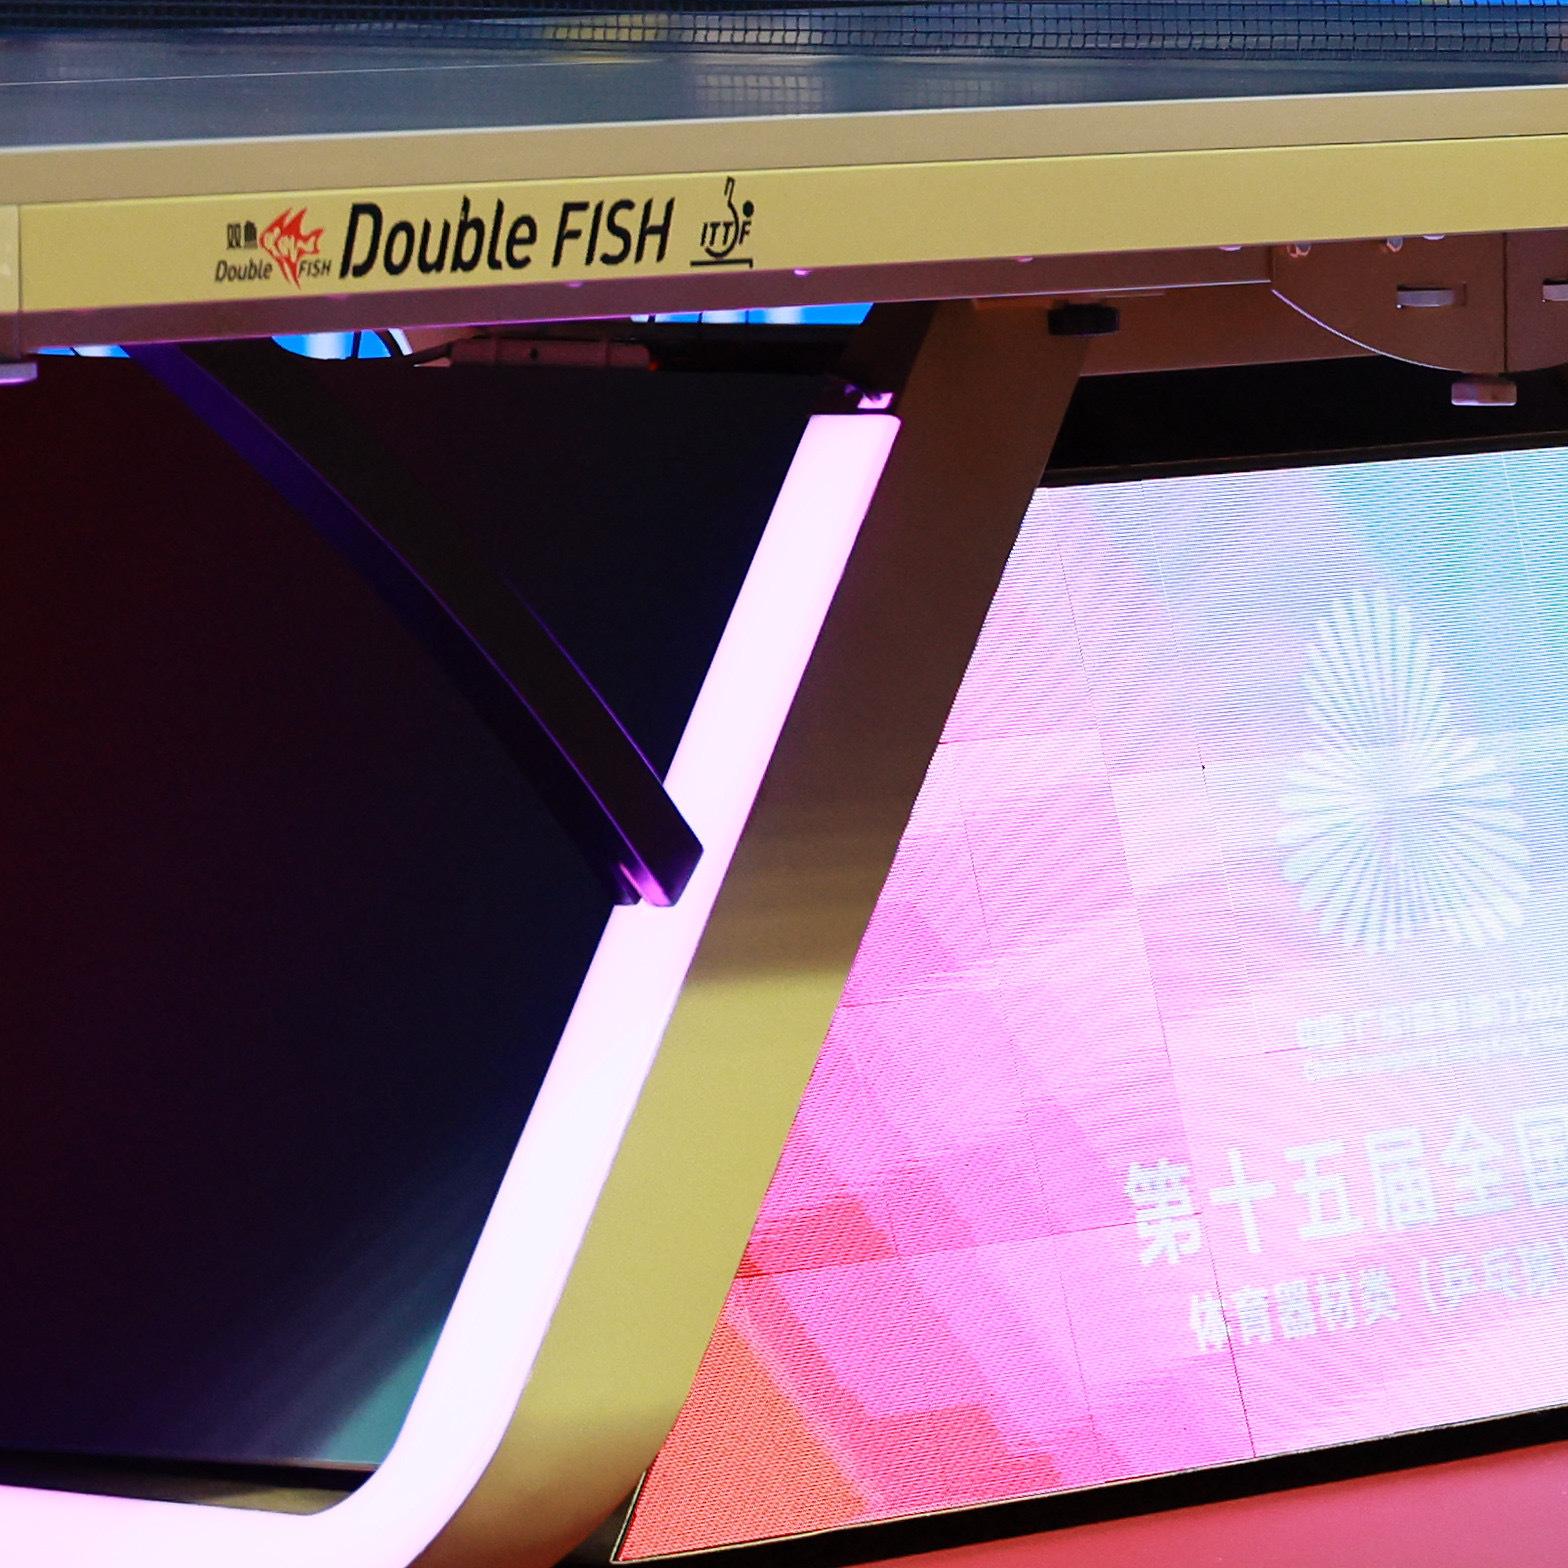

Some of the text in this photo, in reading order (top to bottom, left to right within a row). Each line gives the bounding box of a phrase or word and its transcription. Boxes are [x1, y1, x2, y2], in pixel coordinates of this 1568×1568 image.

[339, 194, 676, 280] Double FISH
[214, 258, 333, 282] Double FISH
